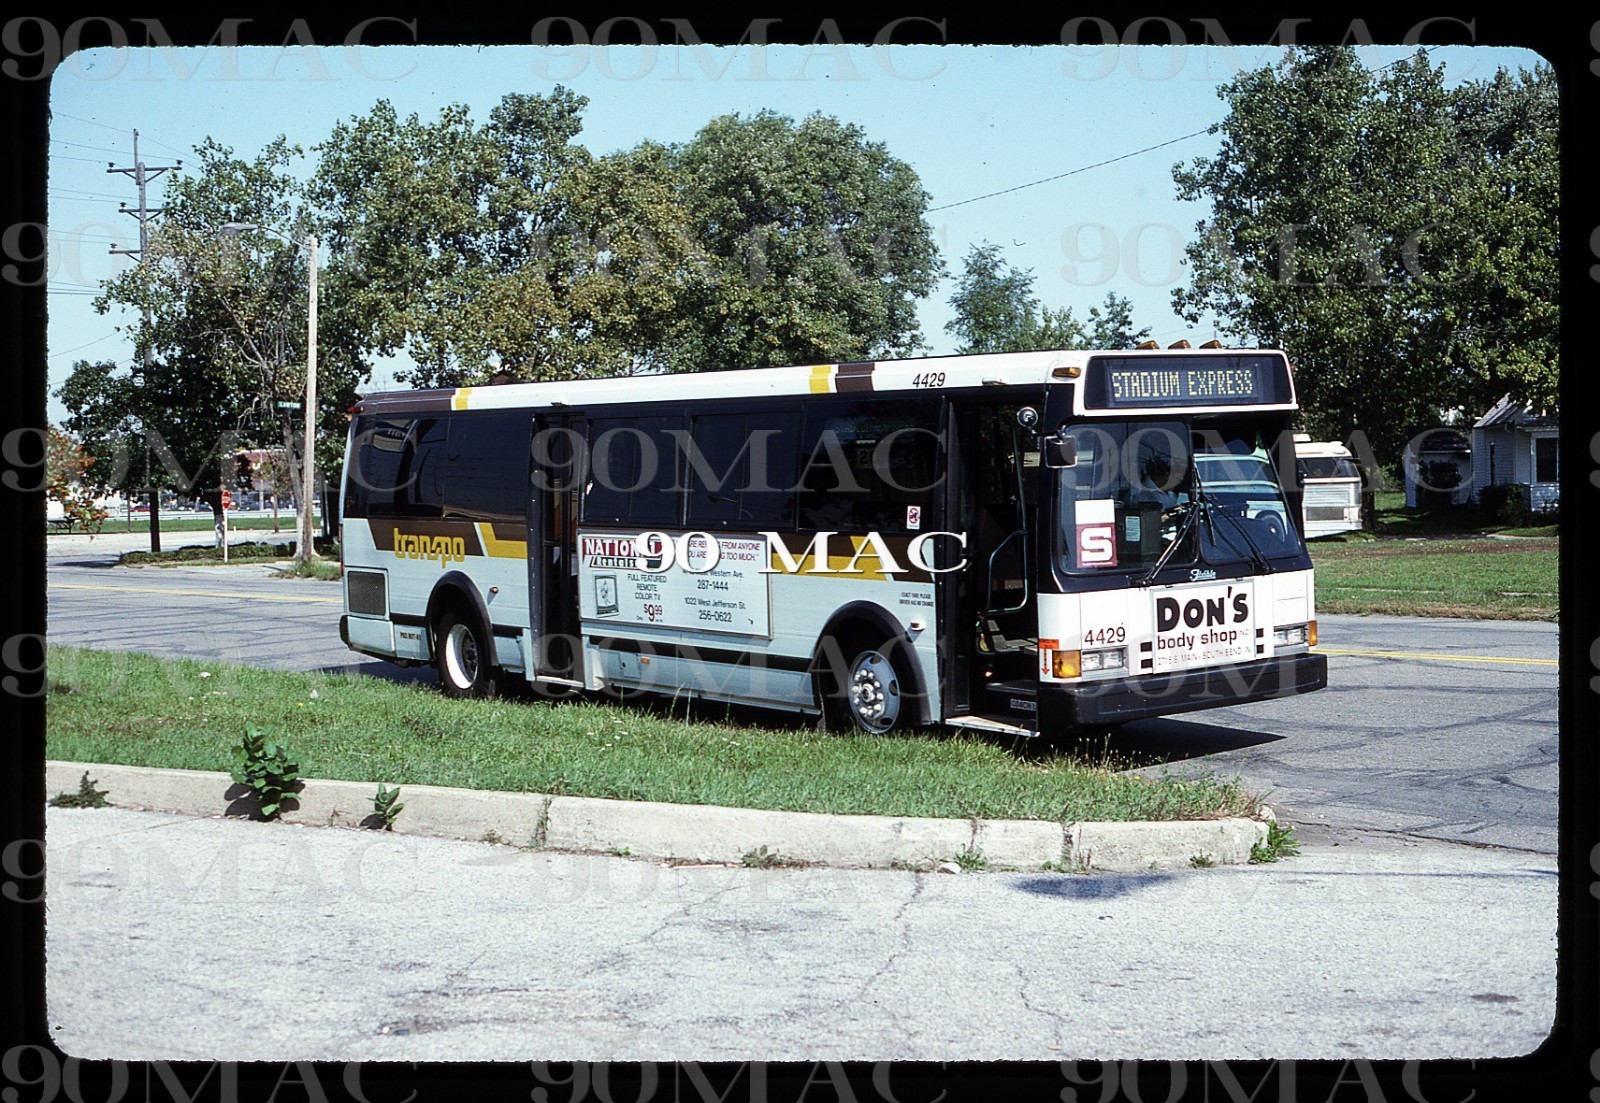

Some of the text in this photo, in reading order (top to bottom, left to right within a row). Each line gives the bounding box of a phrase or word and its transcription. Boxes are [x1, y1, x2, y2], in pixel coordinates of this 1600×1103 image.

[912, 372, 946, 388] 4429
[1112, 370, 1253, 398] STADIUM EXPRESS
[393, 528, 466, 569] transpo
[584, 538, 662, 558] NATION
[721, 541, 737, 550] FROM
[738, 542, 760, 551] ANYONE
[1081, 527, 1113, 561] S
[726, 552, 737, 560] TOO
[627, 573, 668, 583] FULL FEATURED
[697, 579, 729, 591] 287-1444
[636, 583, 658, 592] REMOTE
[634, 592, 661, 601] COLOR TV
[698, 598, 711, 607] West
[712, 599, 738, 609] Jefferson
[698, 609, 732, 623] 256-0622
[1156, 586, 1249, 632] DON'S
[1084, 626, 1126, 646] 4429
[1157, 632, 1195, 651] body
[1200, 628, 1238, 645] shop
